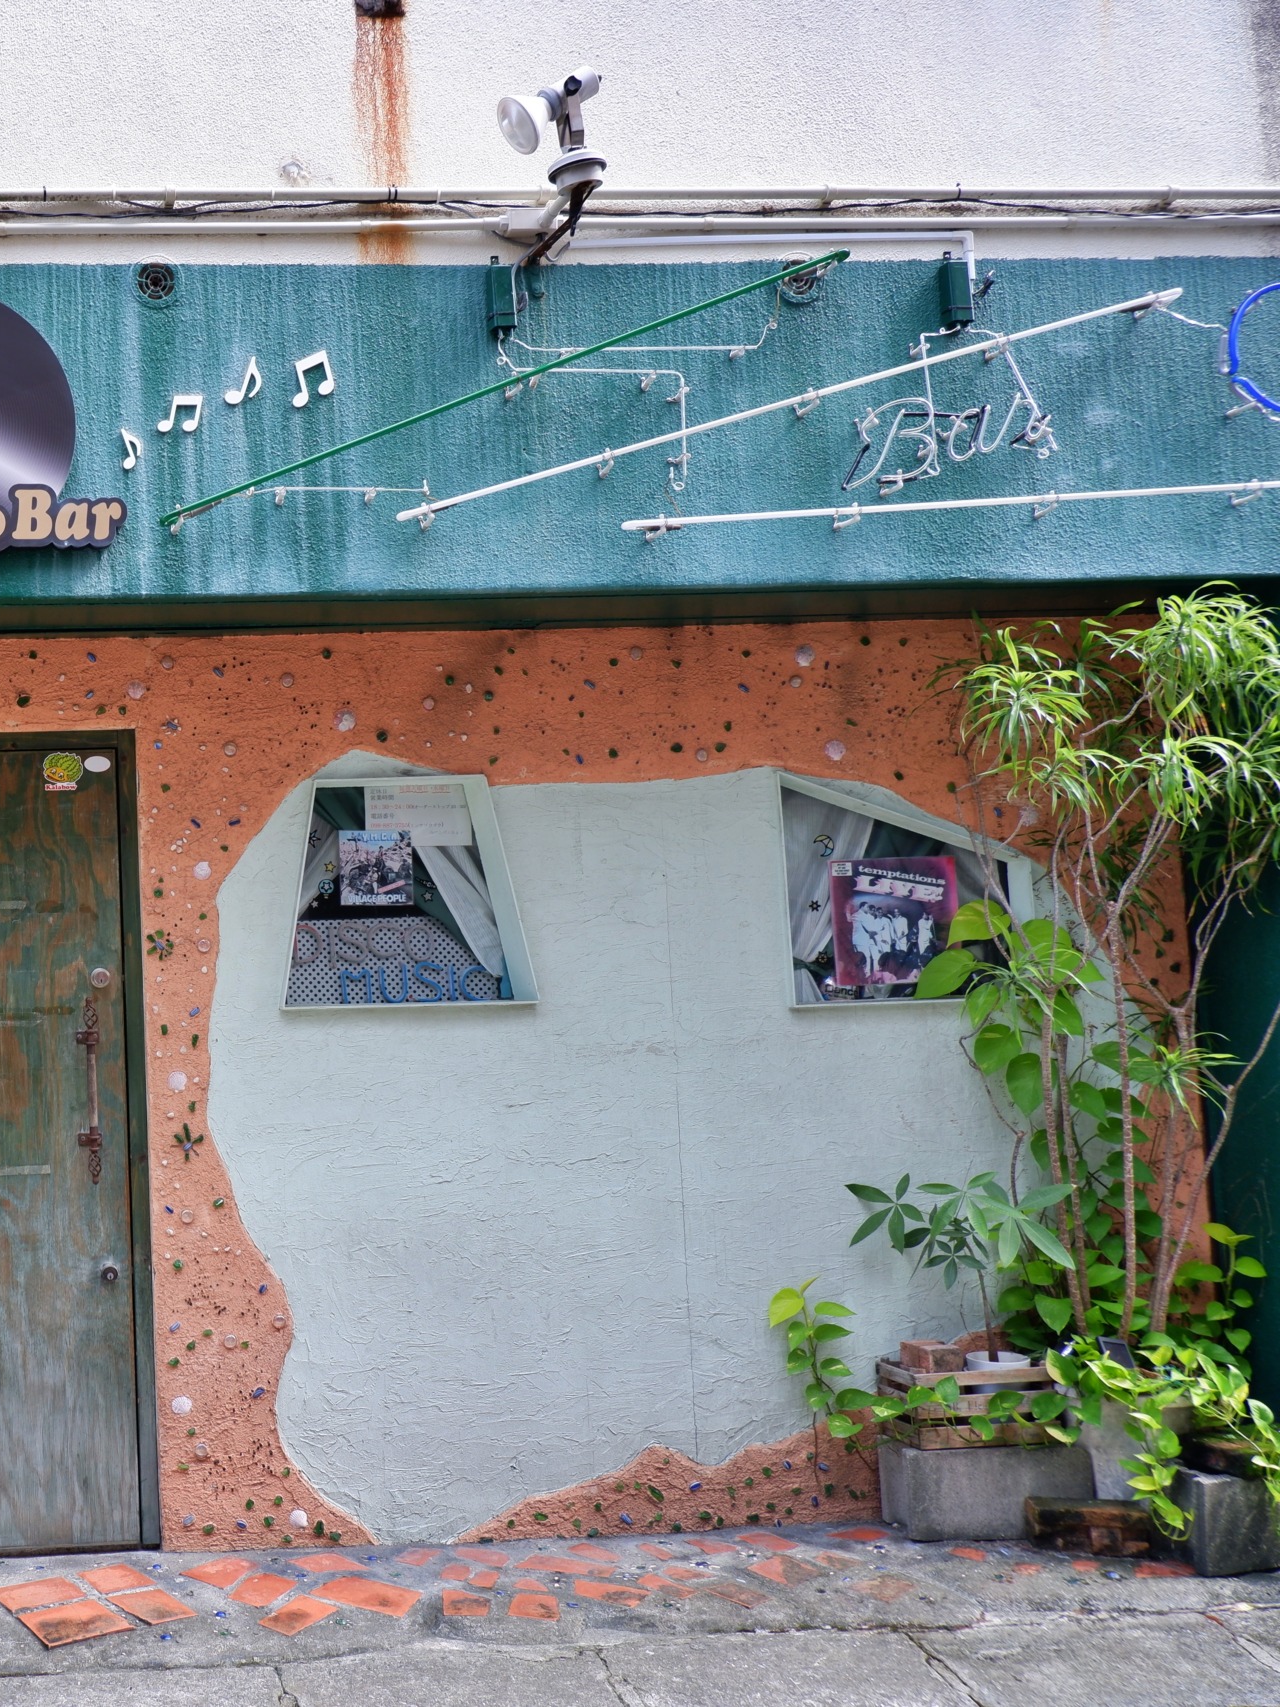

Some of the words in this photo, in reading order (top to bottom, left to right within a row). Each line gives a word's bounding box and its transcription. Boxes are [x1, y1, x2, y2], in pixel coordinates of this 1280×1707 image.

[857, 864, 946, 885] temptations
[348, 893, 377, 904] VILLAGE
[378, 893, 407, 904] PEOPLE
[292, 922, 435, 969] DISCO
[340, 960, 497, 1004] MUSIC
